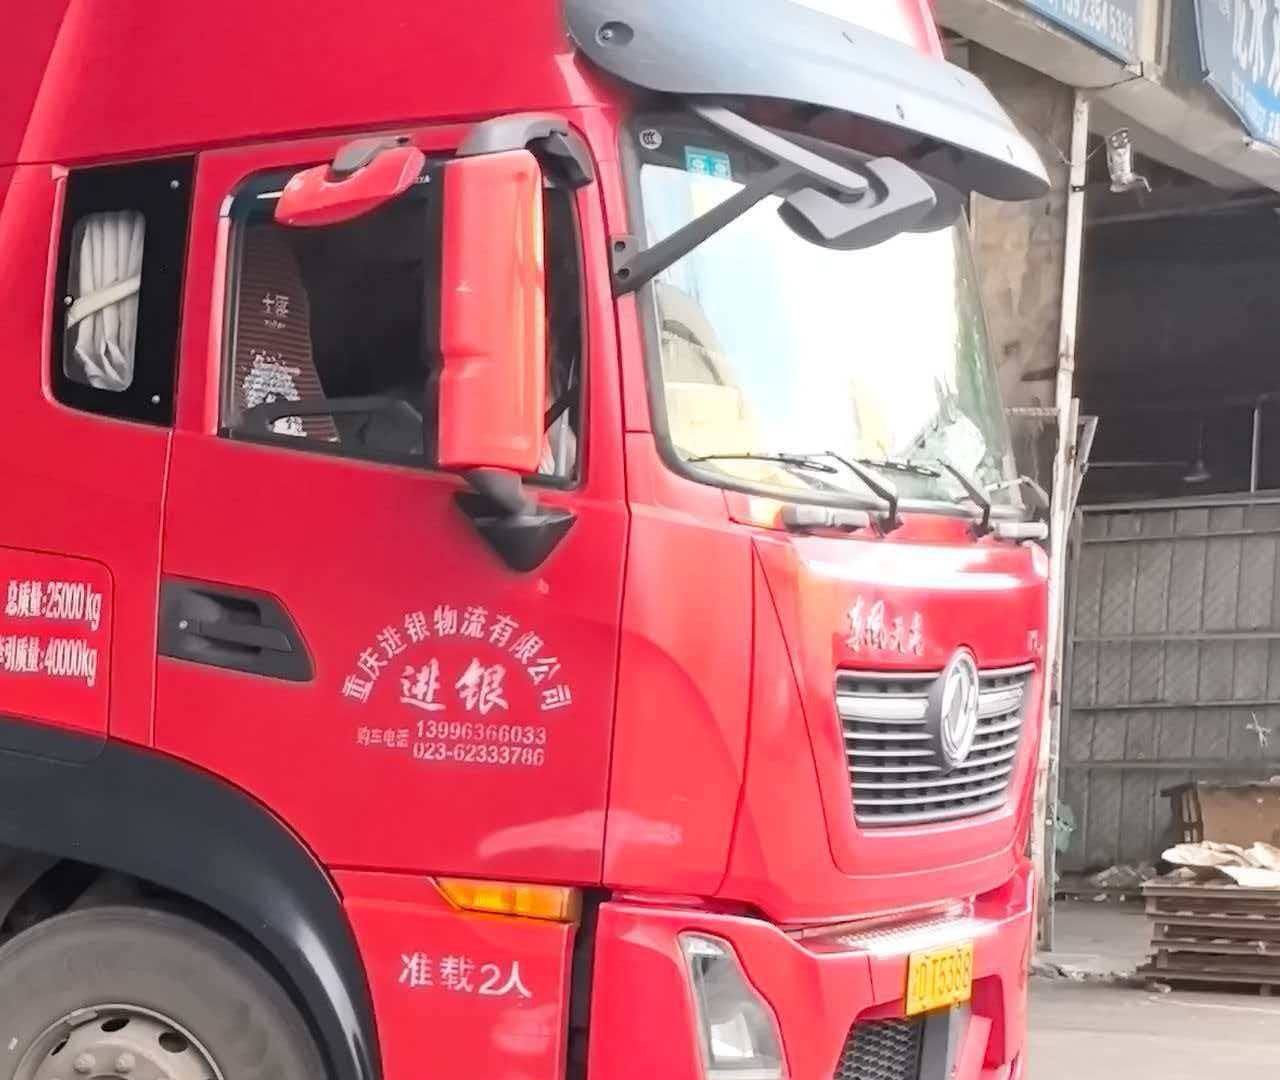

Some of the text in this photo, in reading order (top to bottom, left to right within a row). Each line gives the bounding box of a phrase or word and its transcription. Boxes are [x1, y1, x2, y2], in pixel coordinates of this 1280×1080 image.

[342, 604, 572, 711] 重庆进银物流有限公司
[399, 656, 509, 715] 进银
[415, 719, 547, 745] 13996366033
[397, 951, 532, 998] 准载2人
